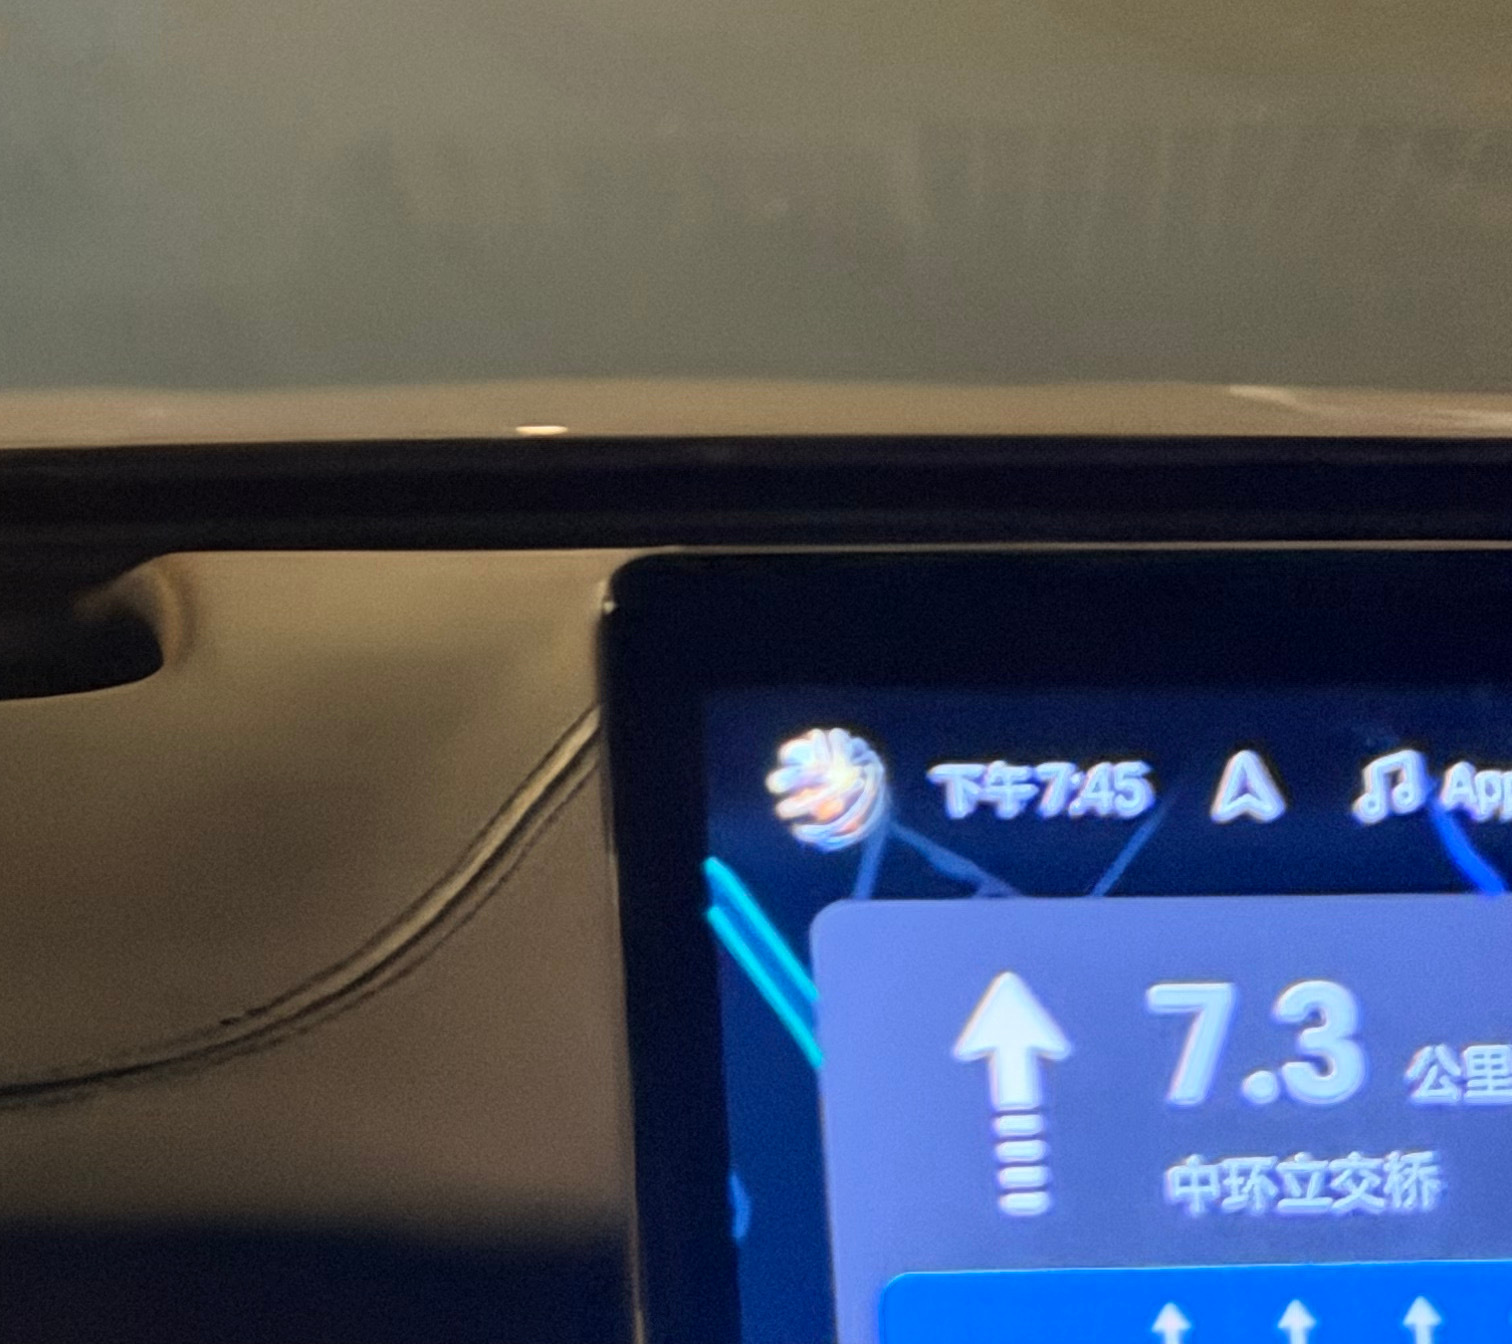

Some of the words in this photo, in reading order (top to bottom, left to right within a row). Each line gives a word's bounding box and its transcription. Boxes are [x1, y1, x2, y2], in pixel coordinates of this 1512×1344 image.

[926, 760, 1156, 819] 下午7:45
[1146, 980, 1365, 1105] 7.3
[1405, 1044, 1512, 1105] 公里
[1165, 1150, 1442, 1215] 中环立交桥
